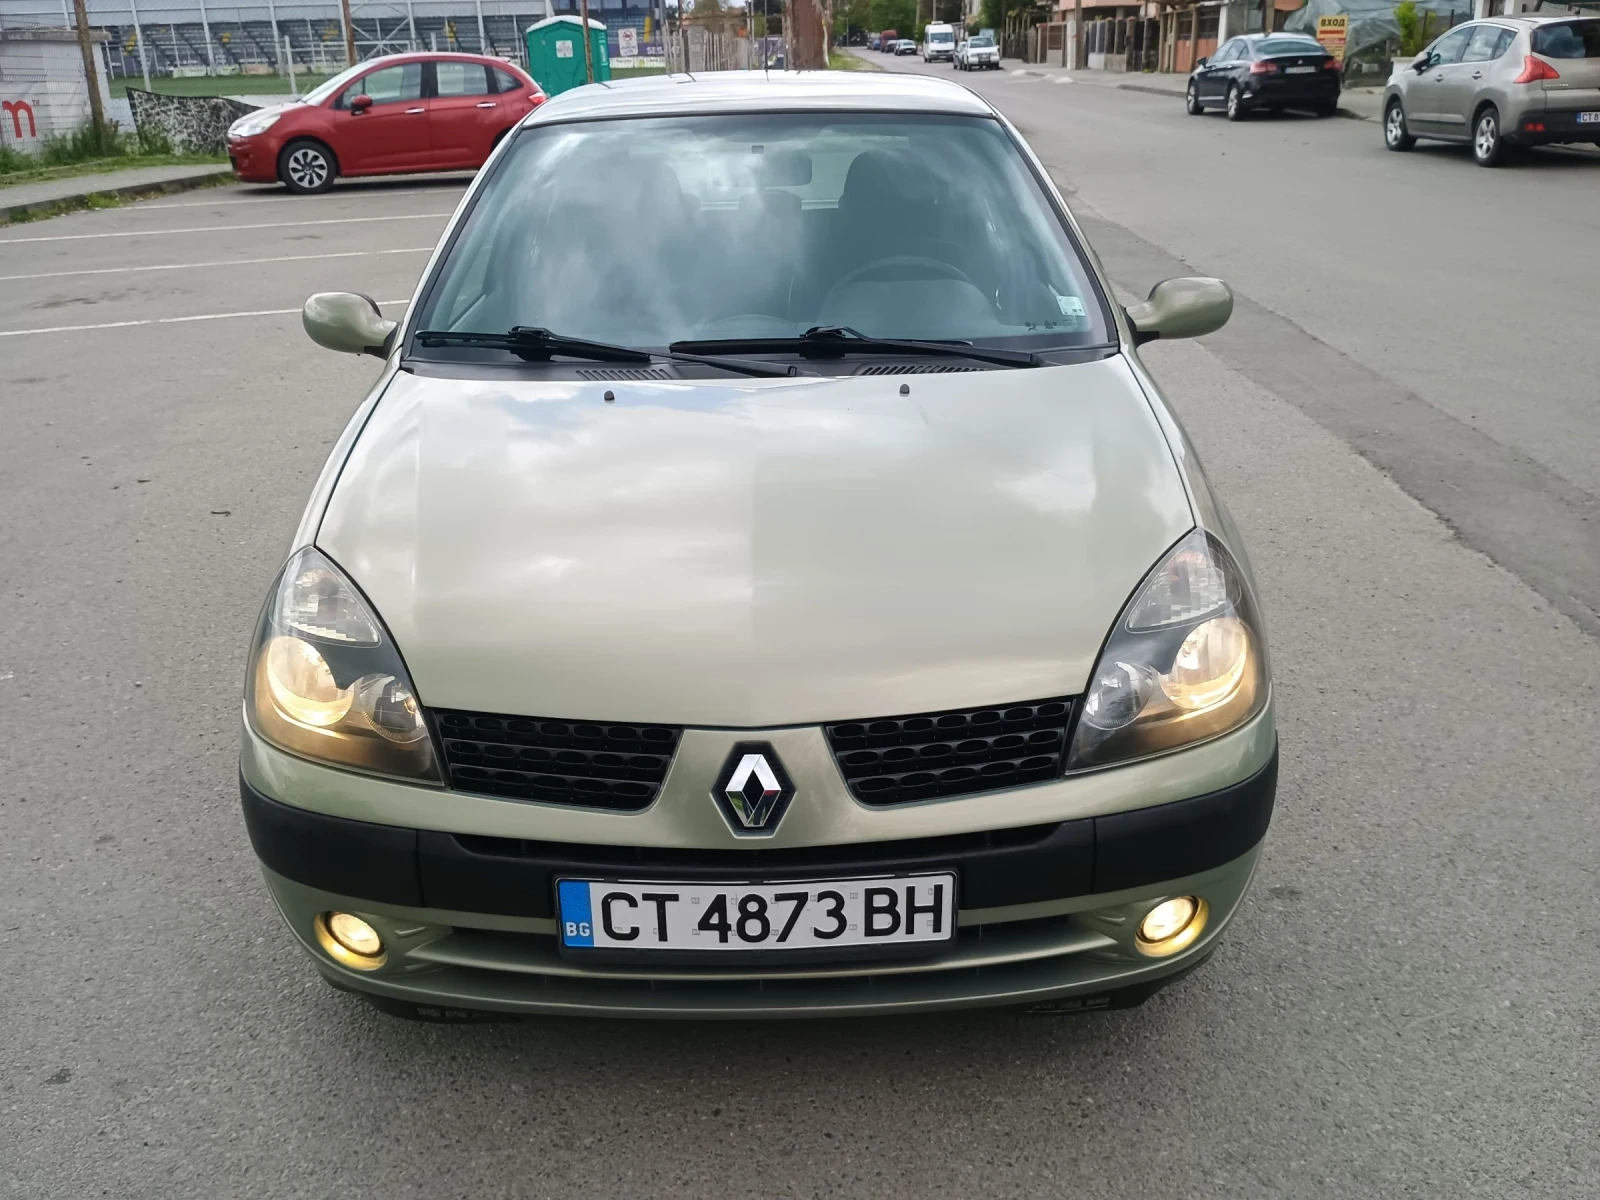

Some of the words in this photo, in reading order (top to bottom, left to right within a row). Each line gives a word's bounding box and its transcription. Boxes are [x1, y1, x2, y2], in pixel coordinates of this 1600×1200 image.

[1321, 18, 1345, 27] ВХОД
[601, 891, 680, 942] CT
[698, 890, 848, 943] 4873
[864, 884, 944, 938] BH
[565, 921, 591, 937] BG
